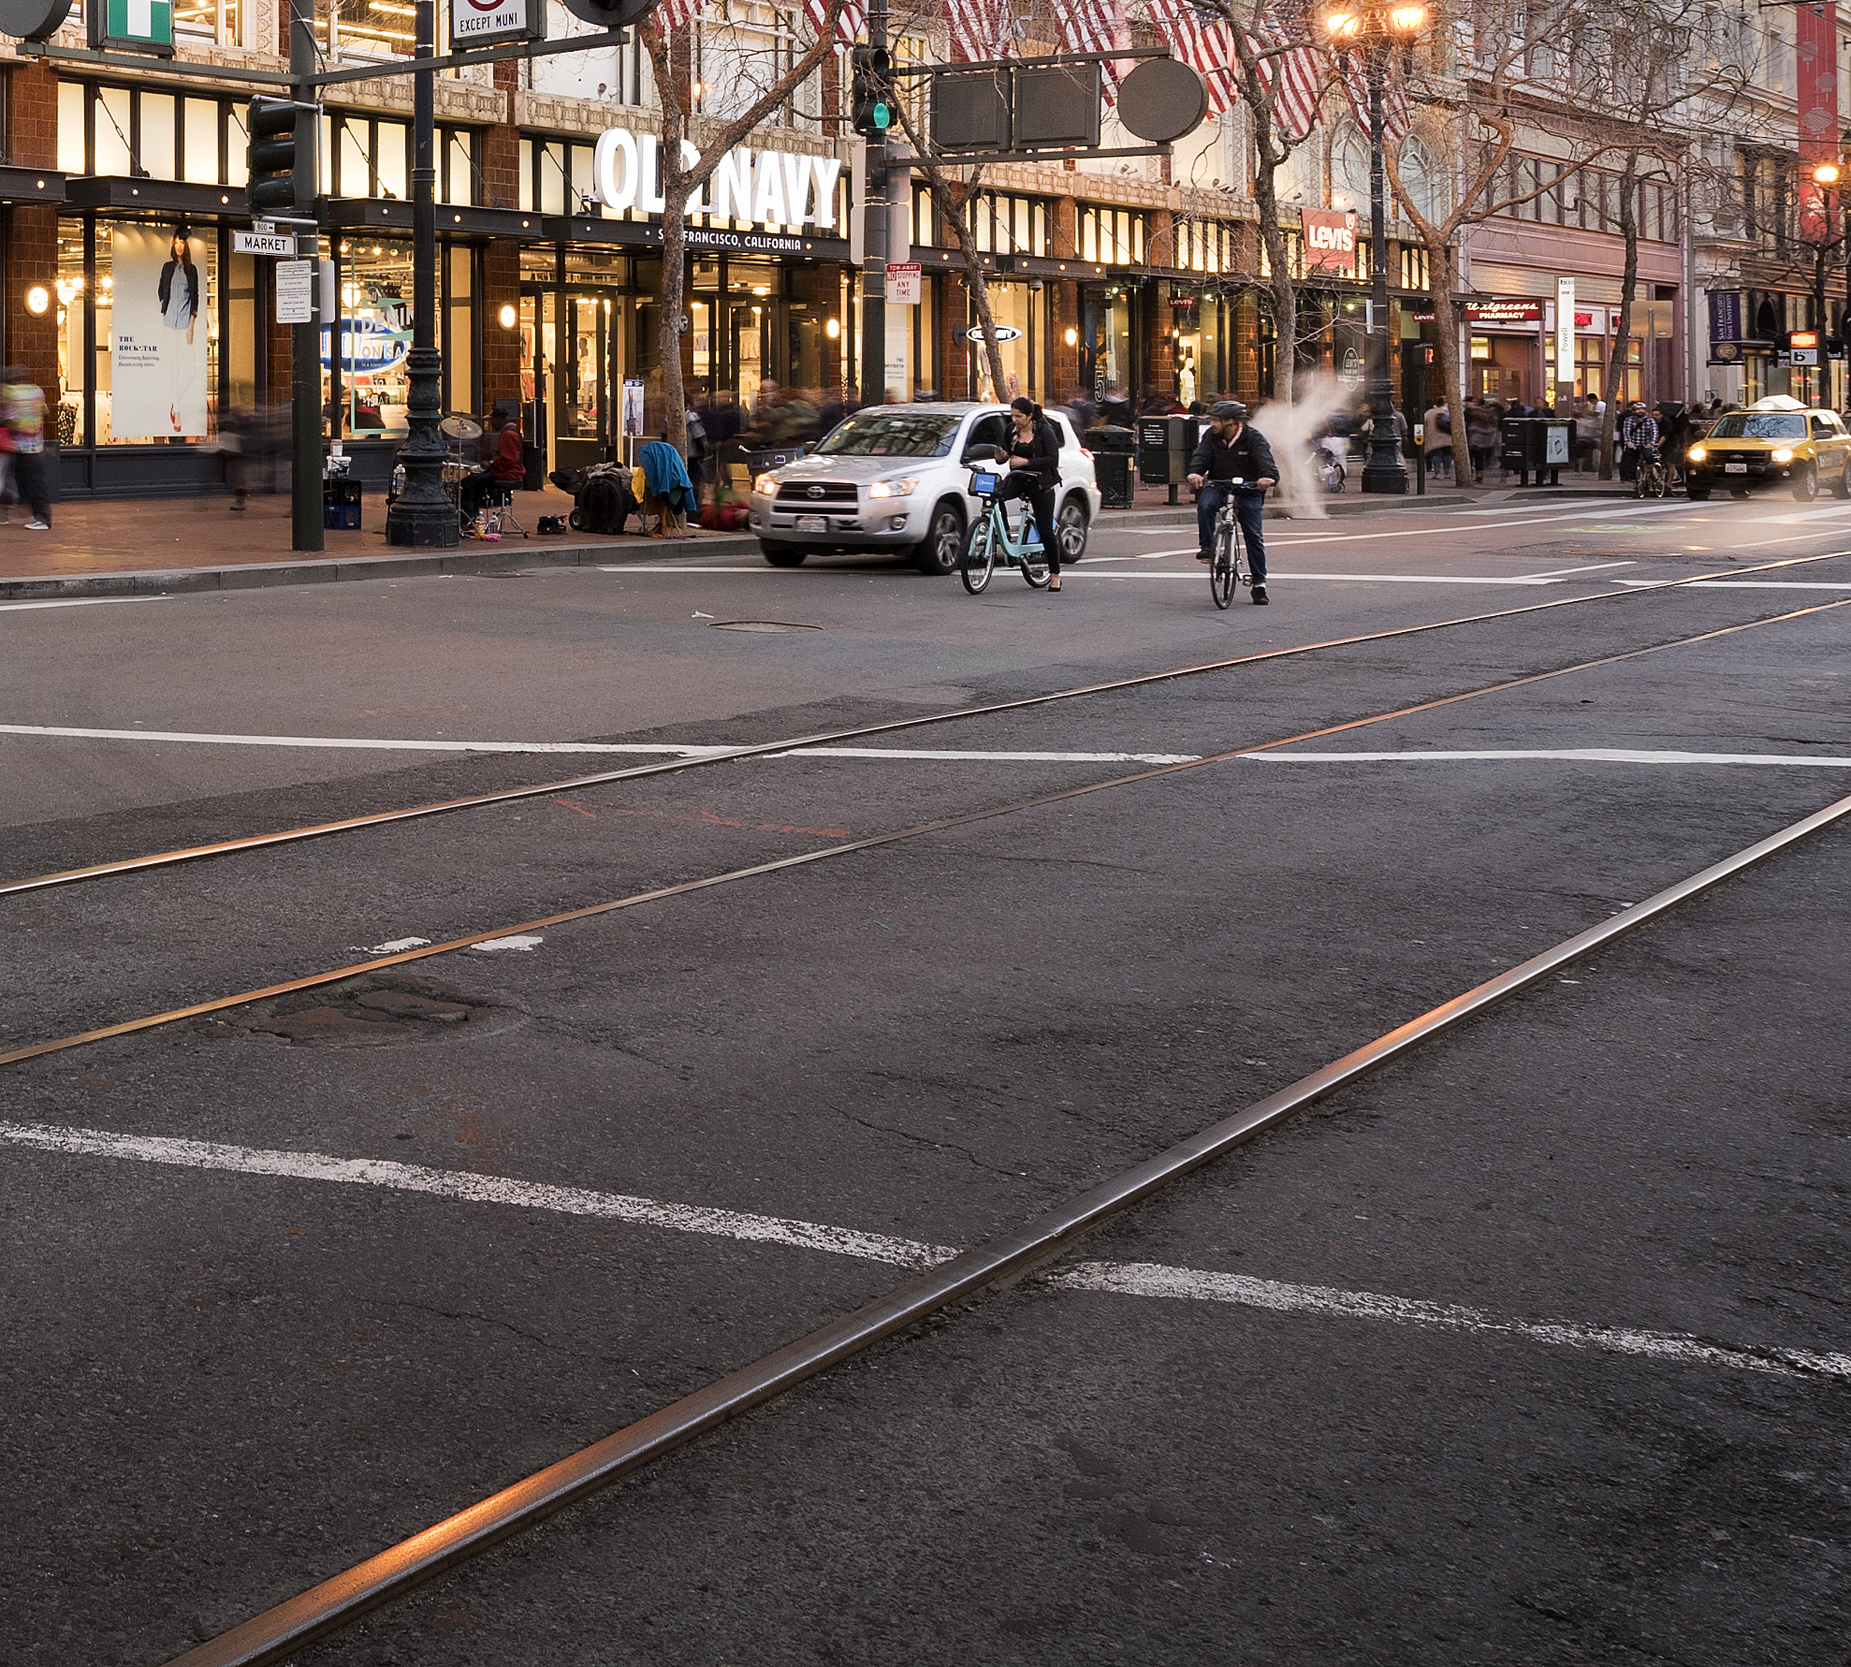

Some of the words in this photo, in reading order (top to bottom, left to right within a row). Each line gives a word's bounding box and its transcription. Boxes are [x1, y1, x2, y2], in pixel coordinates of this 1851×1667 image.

[460, 16, 491, 32] EXCEPT
[495, 12, 518, 27] MUNI
[714, 146, 841, 229] NAVY
[244, 237, 286, 250] MARKET
[684, 231, 741, 247] FRANCISCO,
[744, 236, 801, 250] CALIFORNIA
[1560, 328, 1568, 352] Powell
[362, 346, 381, 358] ON
